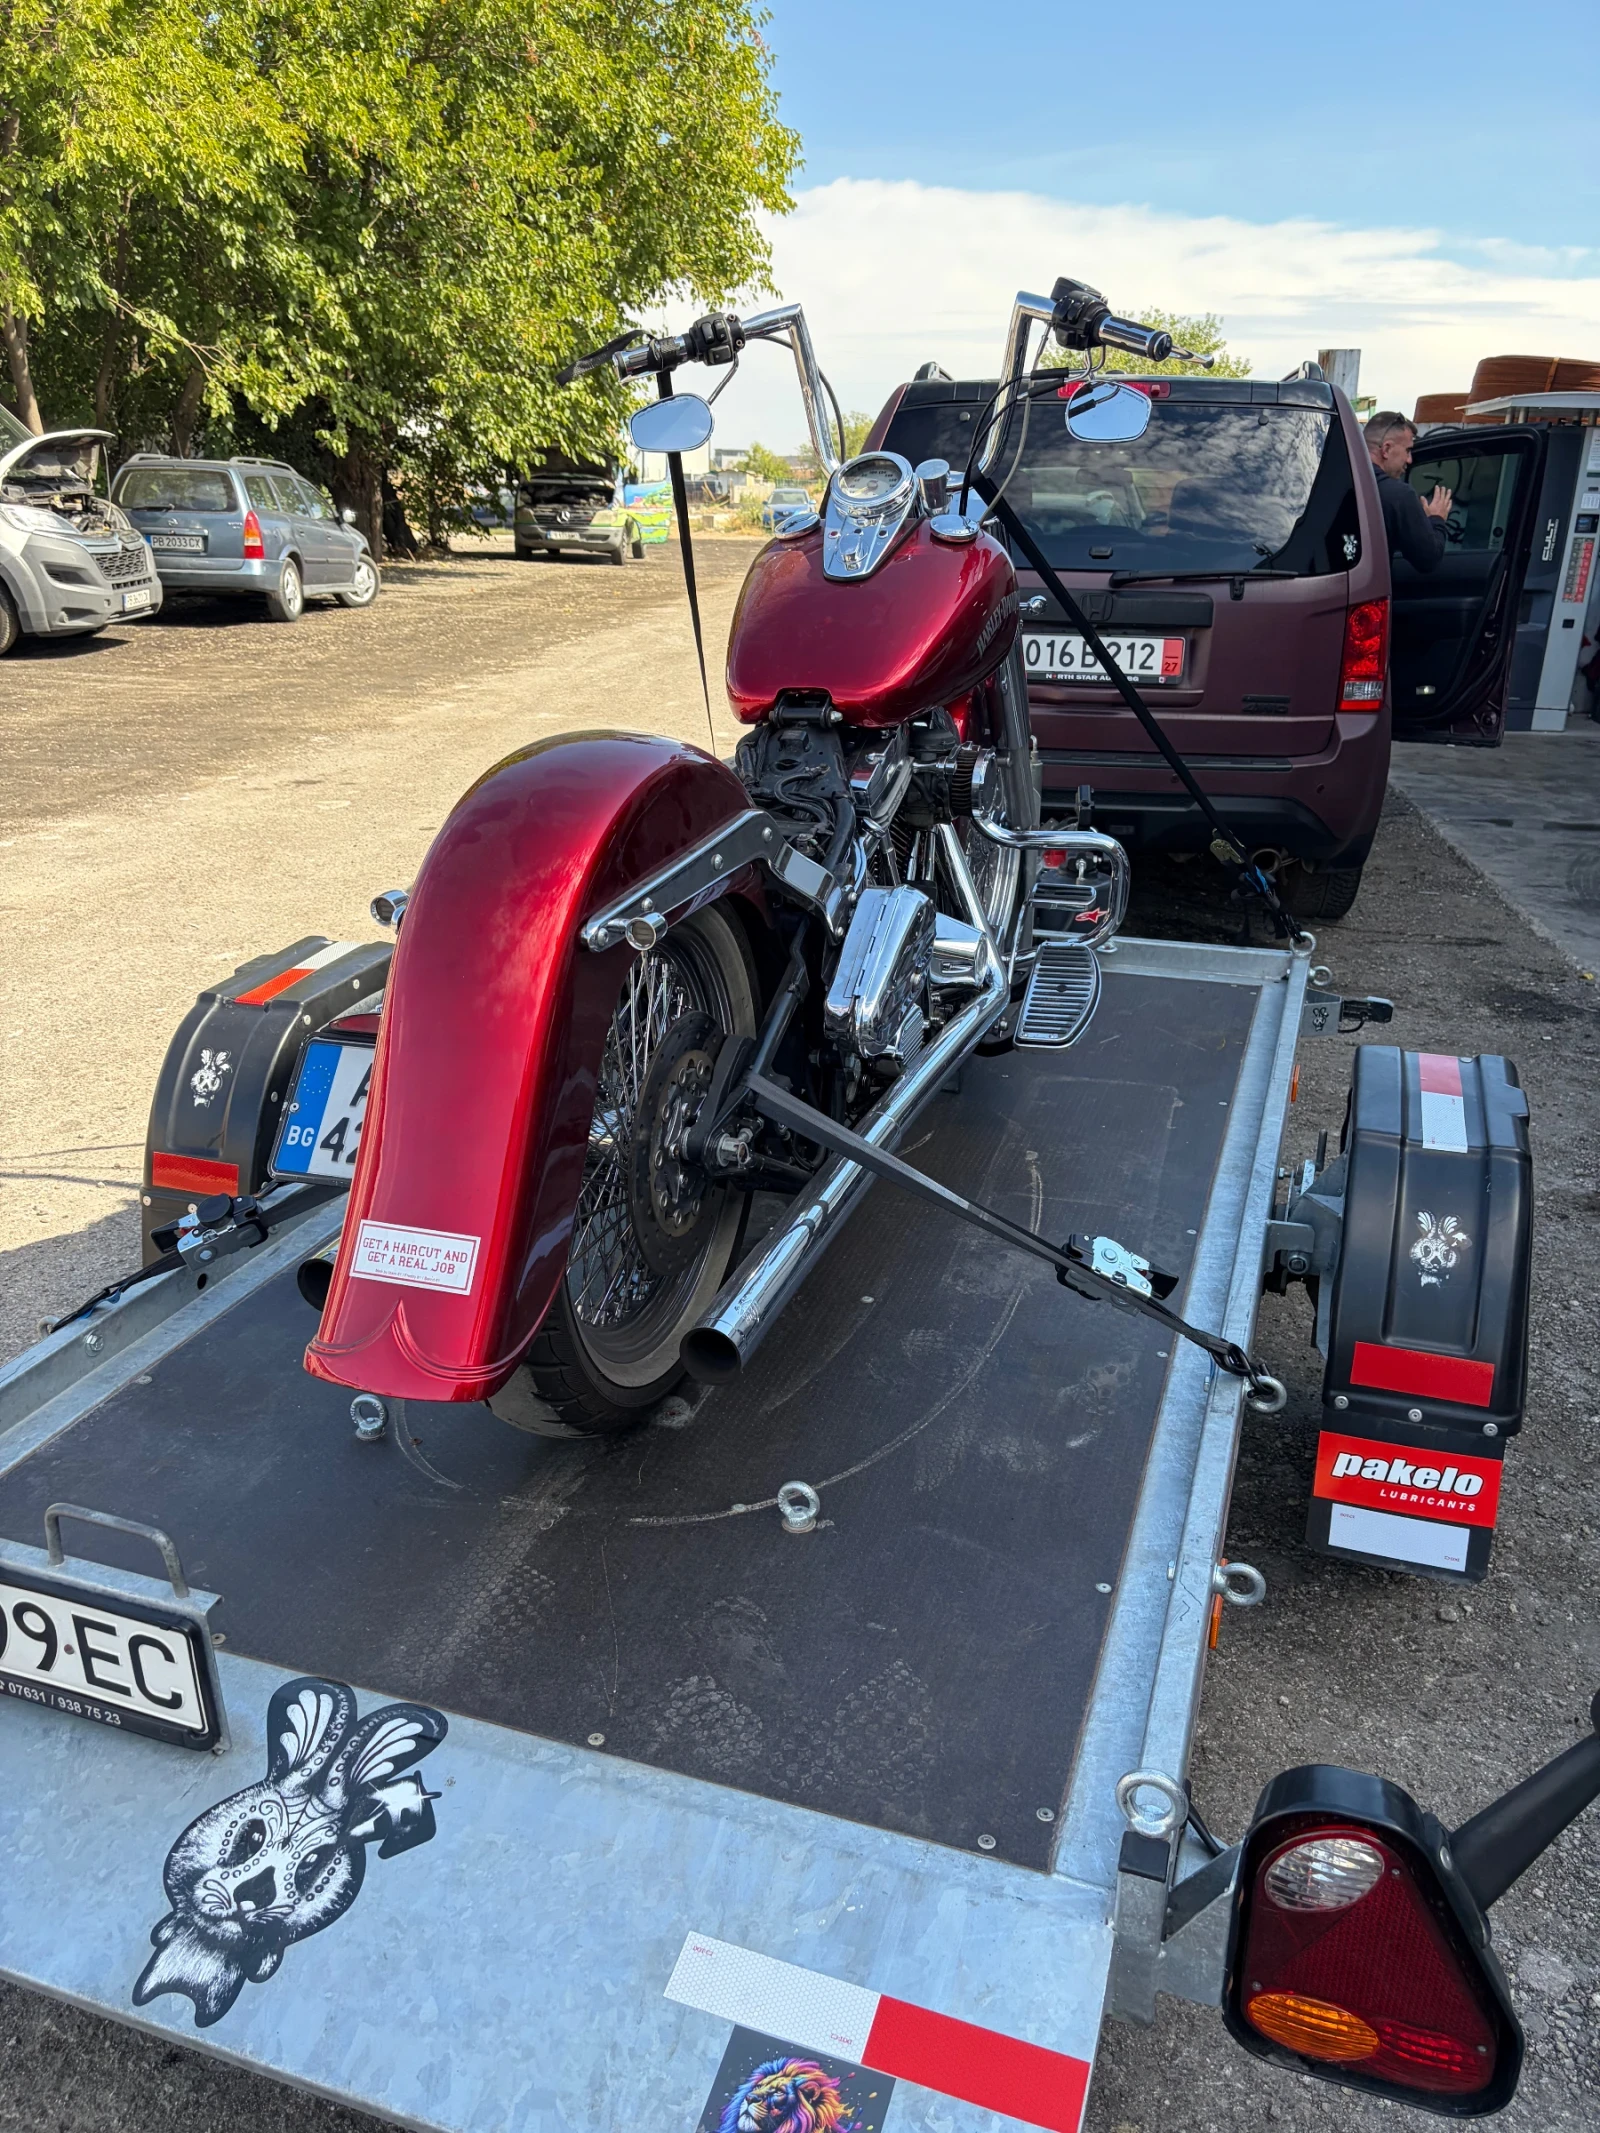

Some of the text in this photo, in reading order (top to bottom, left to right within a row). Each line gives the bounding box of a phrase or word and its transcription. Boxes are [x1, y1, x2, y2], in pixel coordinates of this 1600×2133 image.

[152, 536, 201, 548] PB 2033 CX
[1541, 518, 1555, 561] CULT
[1025, 639, 1075, 668] 016
[1106, 641, 1156, 671] 212
[1164, 662, 1178, 673] 27
[1075, 673, 1098, 681] STAR
[286, 1125, 315, 1147] BG
[362, 1237, 468, 1263] GET A HAIRCUT AND
[367, 1250, 456, 1275] GET A REAL JOB
[1330, 1451, 1485, 1498] pakelo
[1379, 1488, 1477, 1513] LUBRICANTS
[0, 1600, 58, 1674] 9
[8, 1682, 46, 1703] 07631
[57, 1697, 82, 1713] 938
[84, 1705, 102, 1719] 75
[104, 1711, 121, 1725] 23
